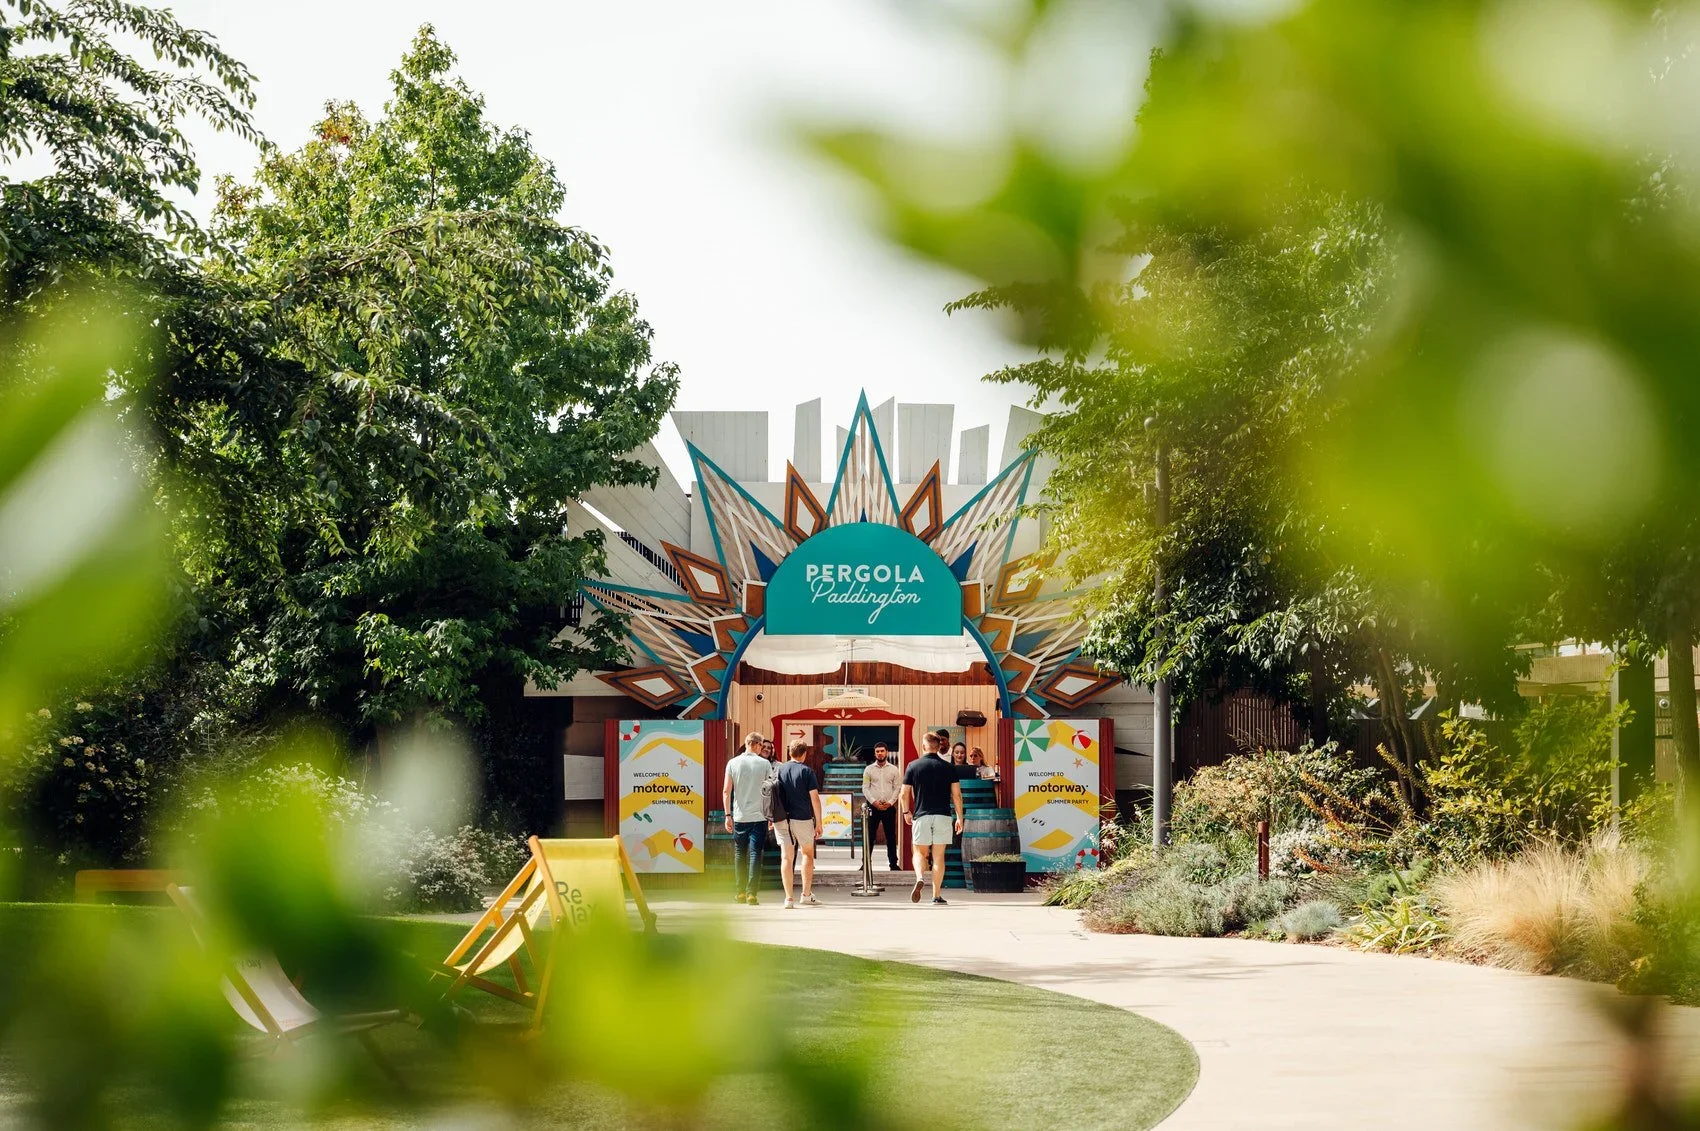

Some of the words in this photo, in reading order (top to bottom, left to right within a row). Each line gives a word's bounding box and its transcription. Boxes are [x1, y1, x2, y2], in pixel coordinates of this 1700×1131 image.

[806, 564, 924, 582] PERGOLA
[811, 575, 921, 624] Paddington
[633, 783, 694, 796] motorway
[1028, 782, 1089, 795] motorway
[555, 881, 582, 905] Re
